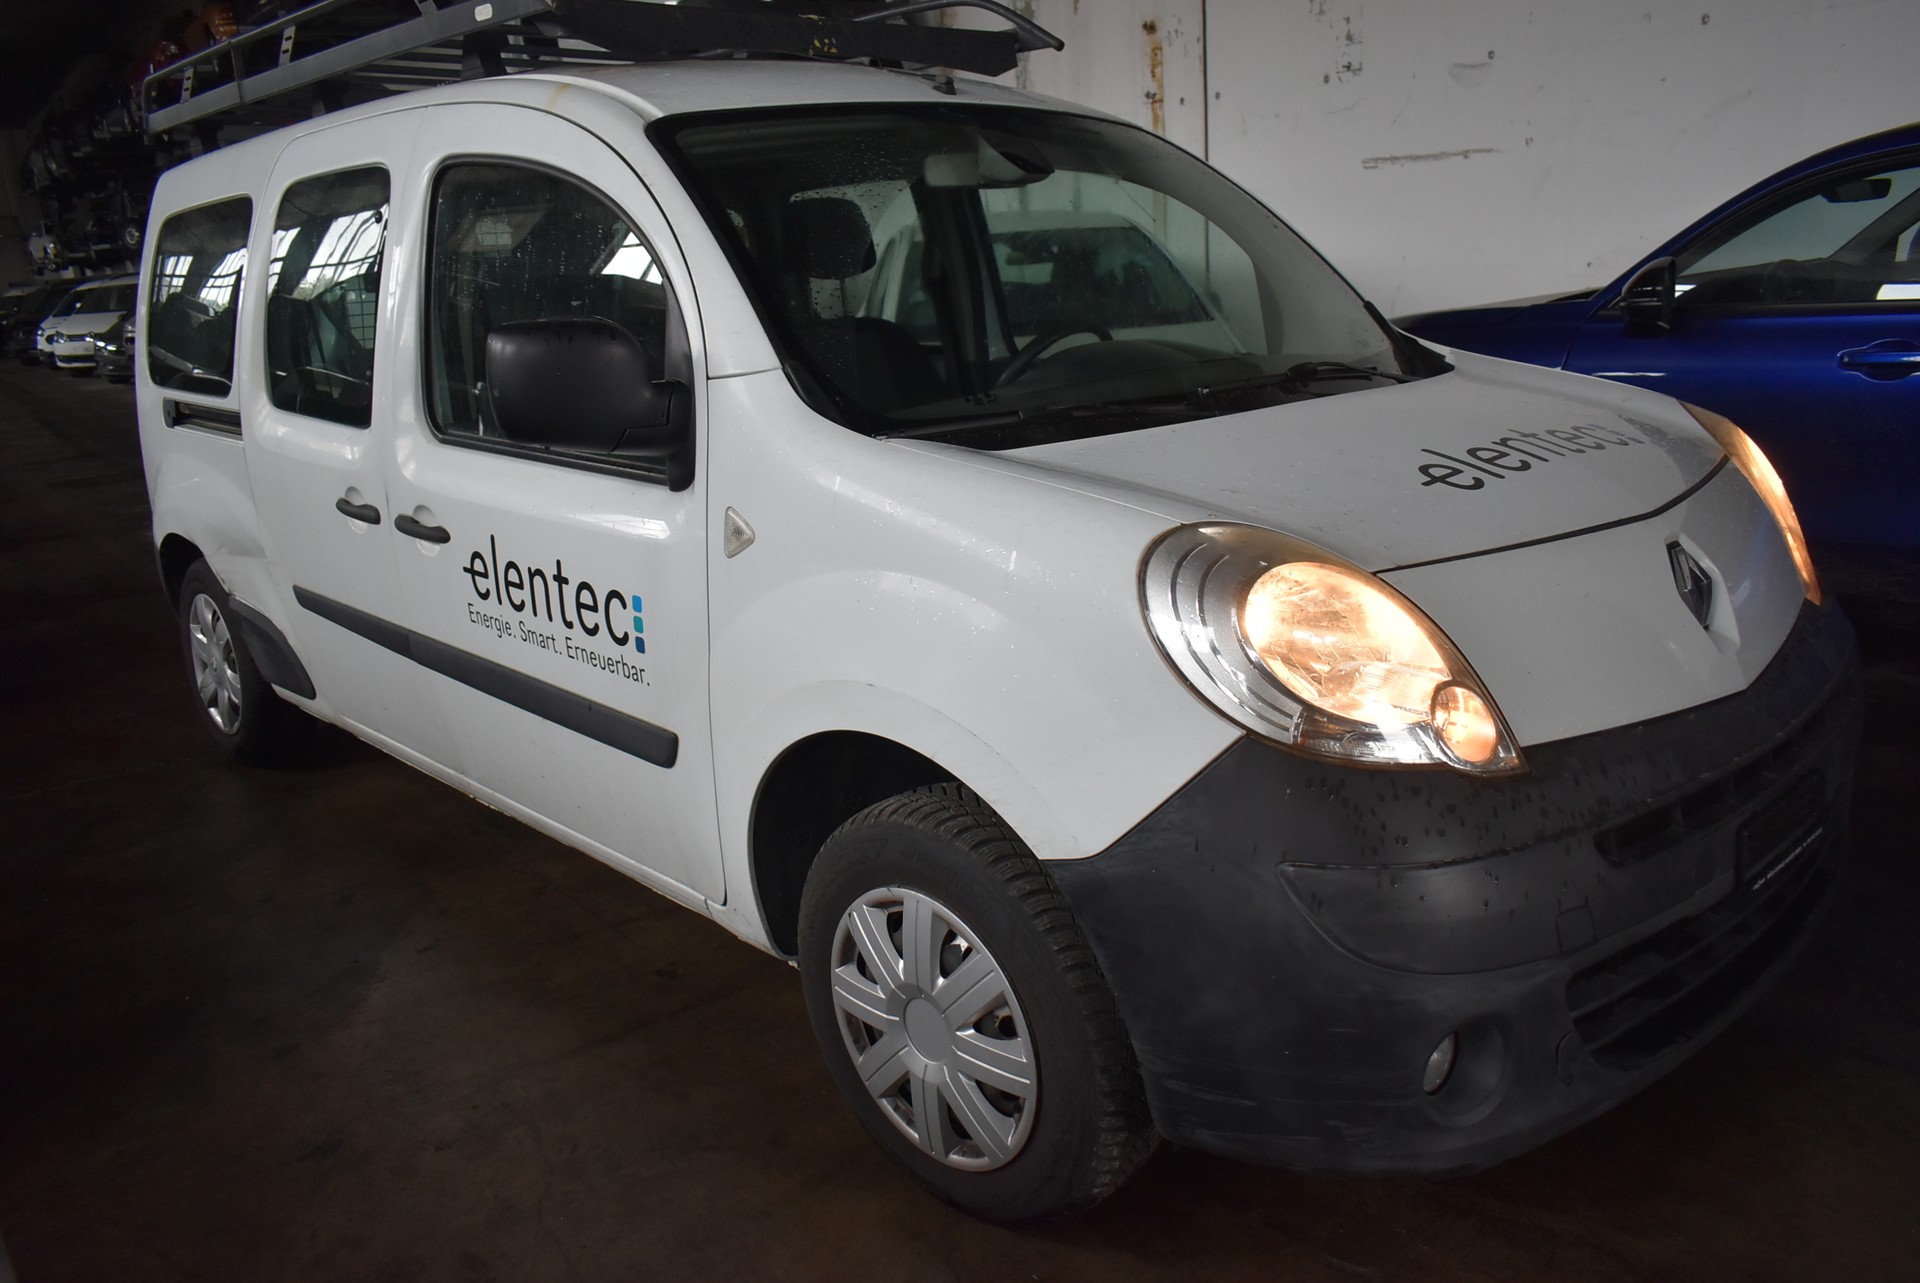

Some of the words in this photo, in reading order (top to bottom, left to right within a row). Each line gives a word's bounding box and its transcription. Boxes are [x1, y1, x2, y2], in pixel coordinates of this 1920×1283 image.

[463, 534, 629, 646] elentec
[467, 602, 517, 638] Energie.
[519, 620, 562, 656] Smart.
[565, 636, 651, 686] Erneuerbar.
